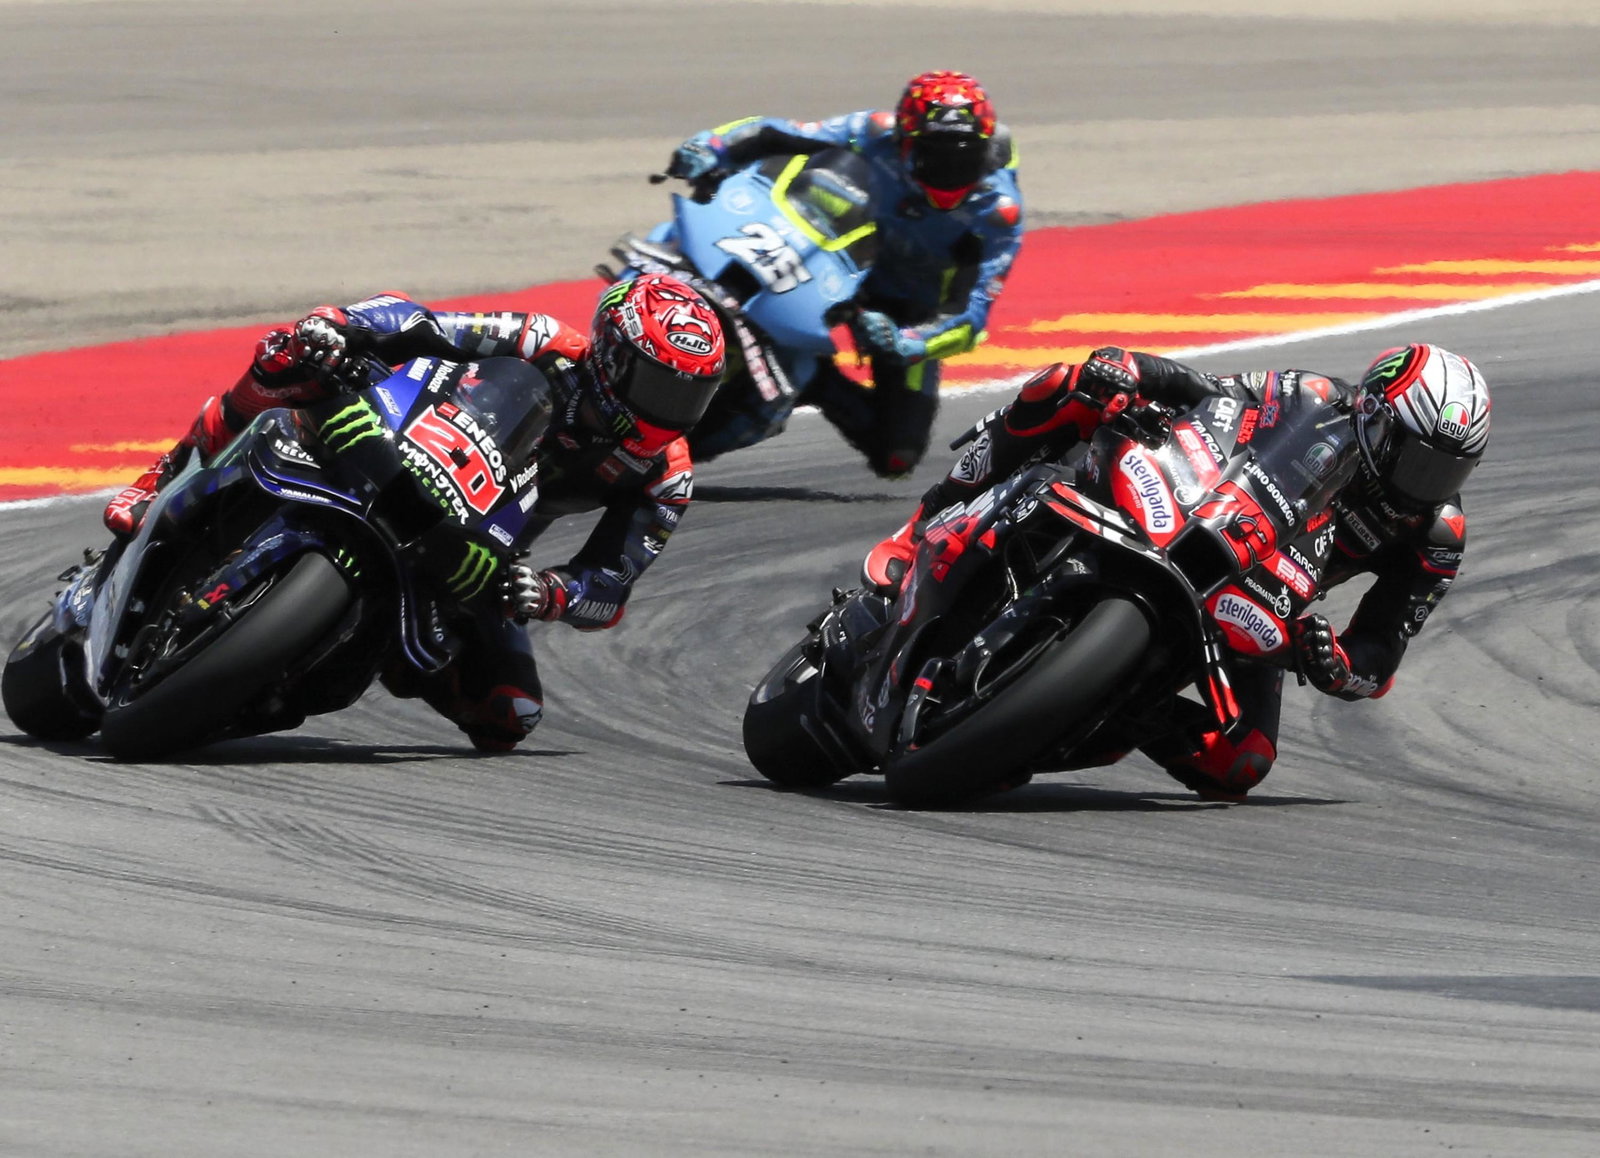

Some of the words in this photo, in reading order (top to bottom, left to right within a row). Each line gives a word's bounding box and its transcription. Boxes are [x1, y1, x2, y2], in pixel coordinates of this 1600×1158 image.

[713, 222, 813, 294] 25
[675, 335, 709, 351] HJC
[453, 411, 508, 483] ENEOS
[1190, 419, 1224, 464] TARGA
[1442, 418, 1467, 437] agv
[403, 403, 506, 516] 20
[401, 459, 456, 518] ENERGY
[1124, 454, 1172, 529] sterilgarda
[1243, 461, 1269, 485] LINO
[1266, 482, 1295, 527] SONEGO
[1276, 557, 1311, 592] BS
[1289, 545, 1319, 582] TARGA
[1244, 576, 1277, 605] PRAGMATIC
[1219, 597, 1278, 648] sterilgarda
